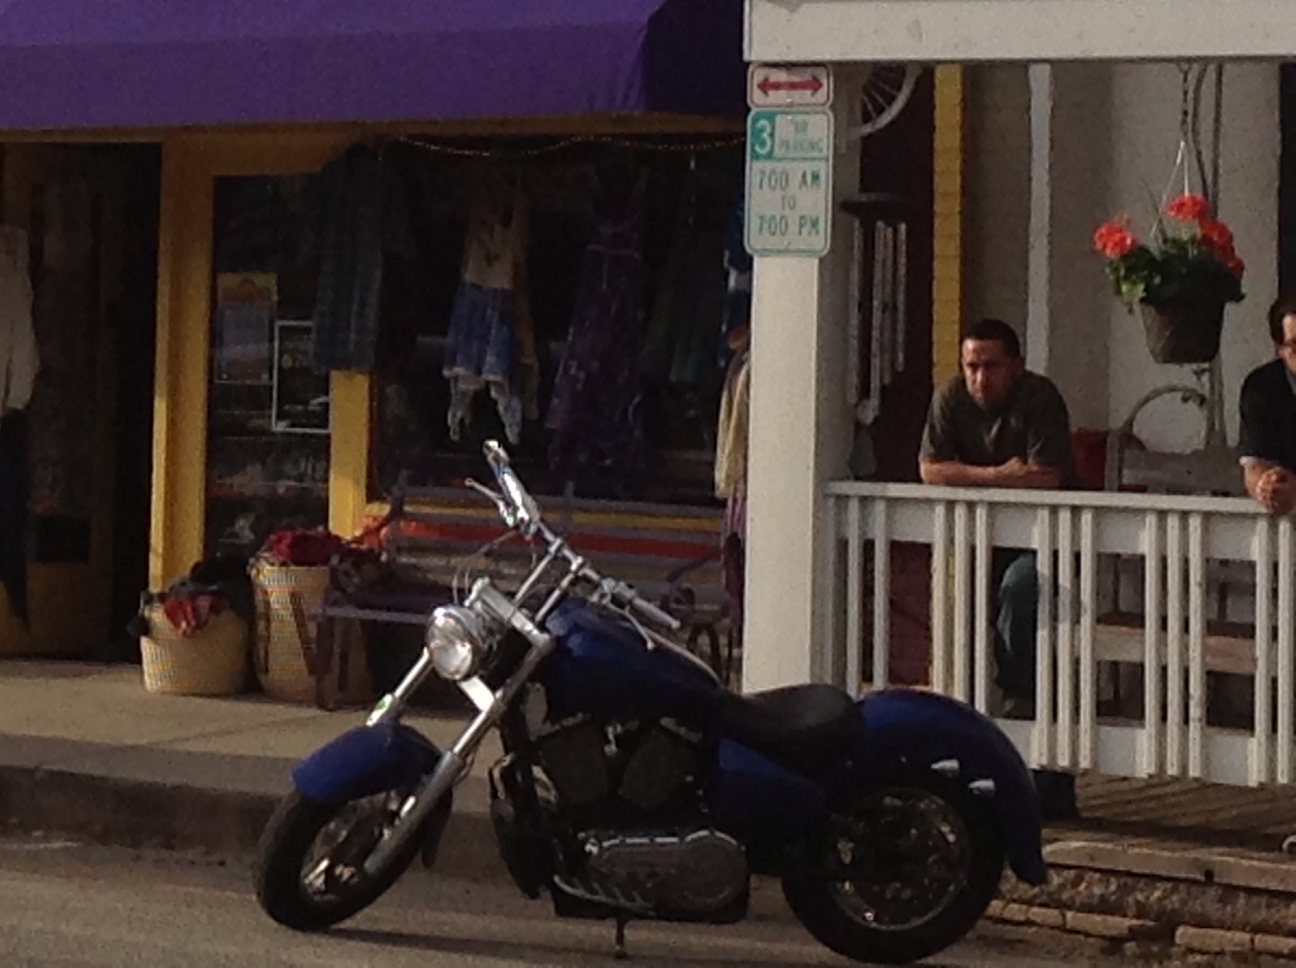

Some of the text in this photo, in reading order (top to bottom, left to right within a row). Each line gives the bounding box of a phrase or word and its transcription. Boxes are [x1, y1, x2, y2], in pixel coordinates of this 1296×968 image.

[754, 118, 772, 154] 3
[799, 170, 820, 189] AM
[781, 194, 796, 210] TO
[798, 216, 820, 236] PM
